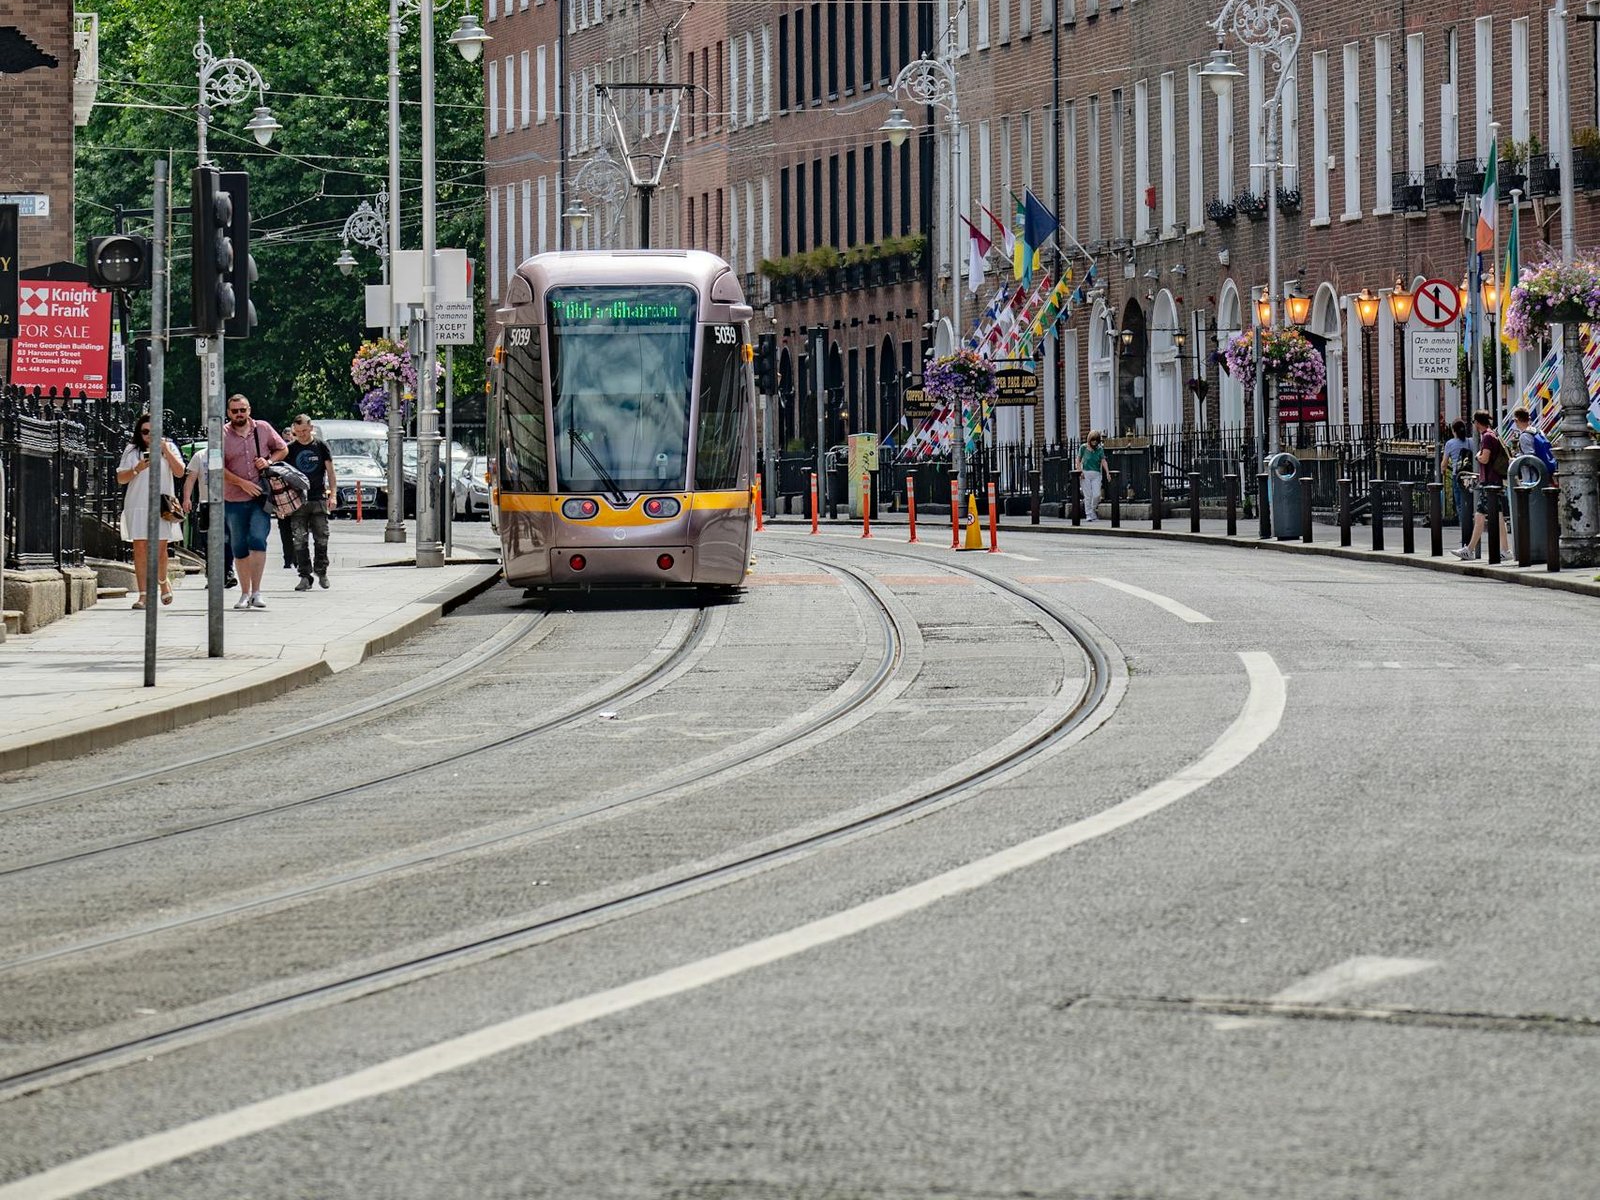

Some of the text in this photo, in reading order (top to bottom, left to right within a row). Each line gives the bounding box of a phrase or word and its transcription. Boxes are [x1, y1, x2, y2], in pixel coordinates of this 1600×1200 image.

[52, 288, 98, 306] Knight
[51, 304, 90, 317] Frank
[18, 324, 91, 339] FOR SALE
[510, 328, 531, 346] 5039
[714, 326, 736, 344] 5039
[17, 341, 104, 352] Prime Georgian Buildings
[28, 349, 59, 357] Harcourt
[1418, 357, 1451, 365] EXCEPT
